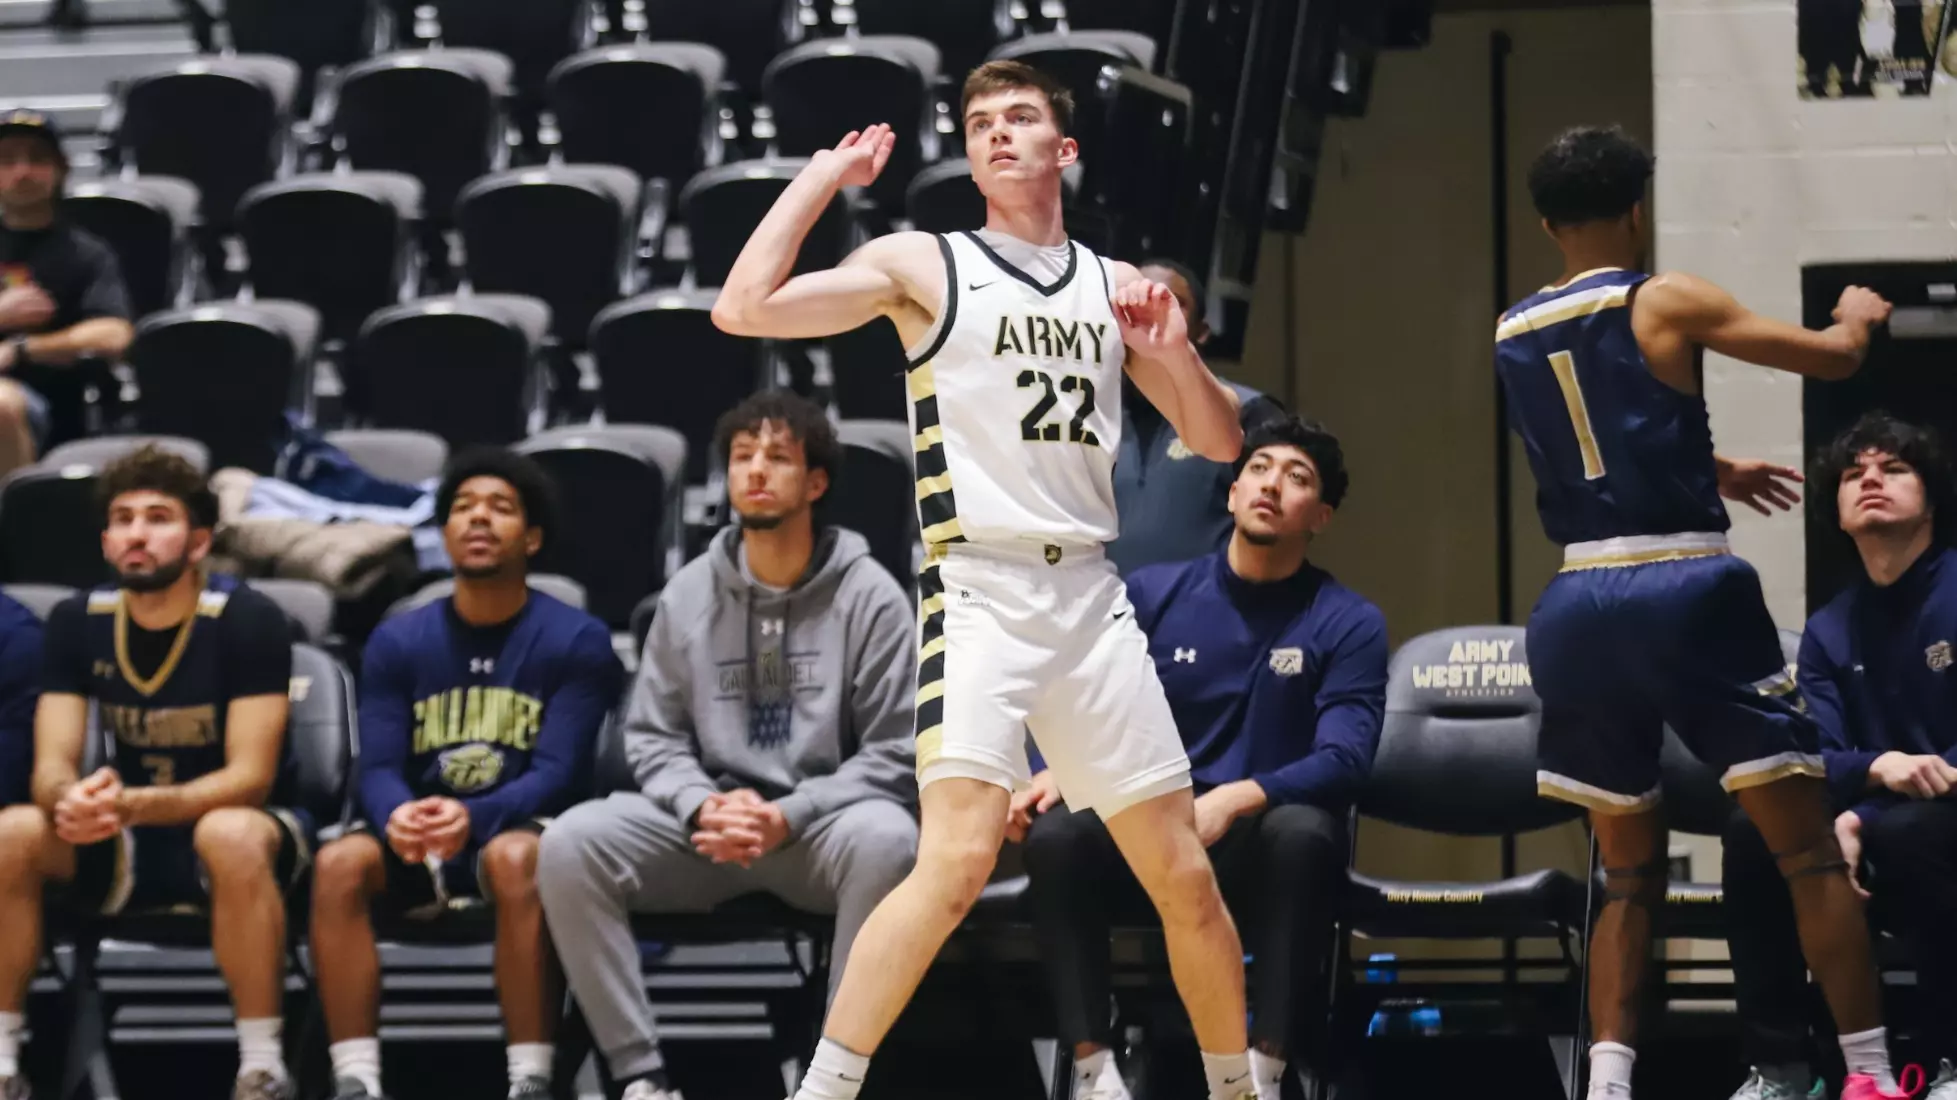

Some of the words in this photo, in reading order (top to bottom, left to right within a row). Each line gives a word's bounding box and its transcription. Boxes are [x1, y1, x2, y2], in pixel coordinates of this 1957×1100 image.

[993, 315, 1106, 365] ARMY
[1015, 369, 1100, 447] 22
[1547, 350, 1606, 480] 1
[1447, 640, 1514, 663] ARMY
[1412, 664, 1478, 689] WEST
[1481, 663, 1532, 687] POIN
[1412, 889, 1441, 903] Honor
[1443, 888, 1483, 904] Country
